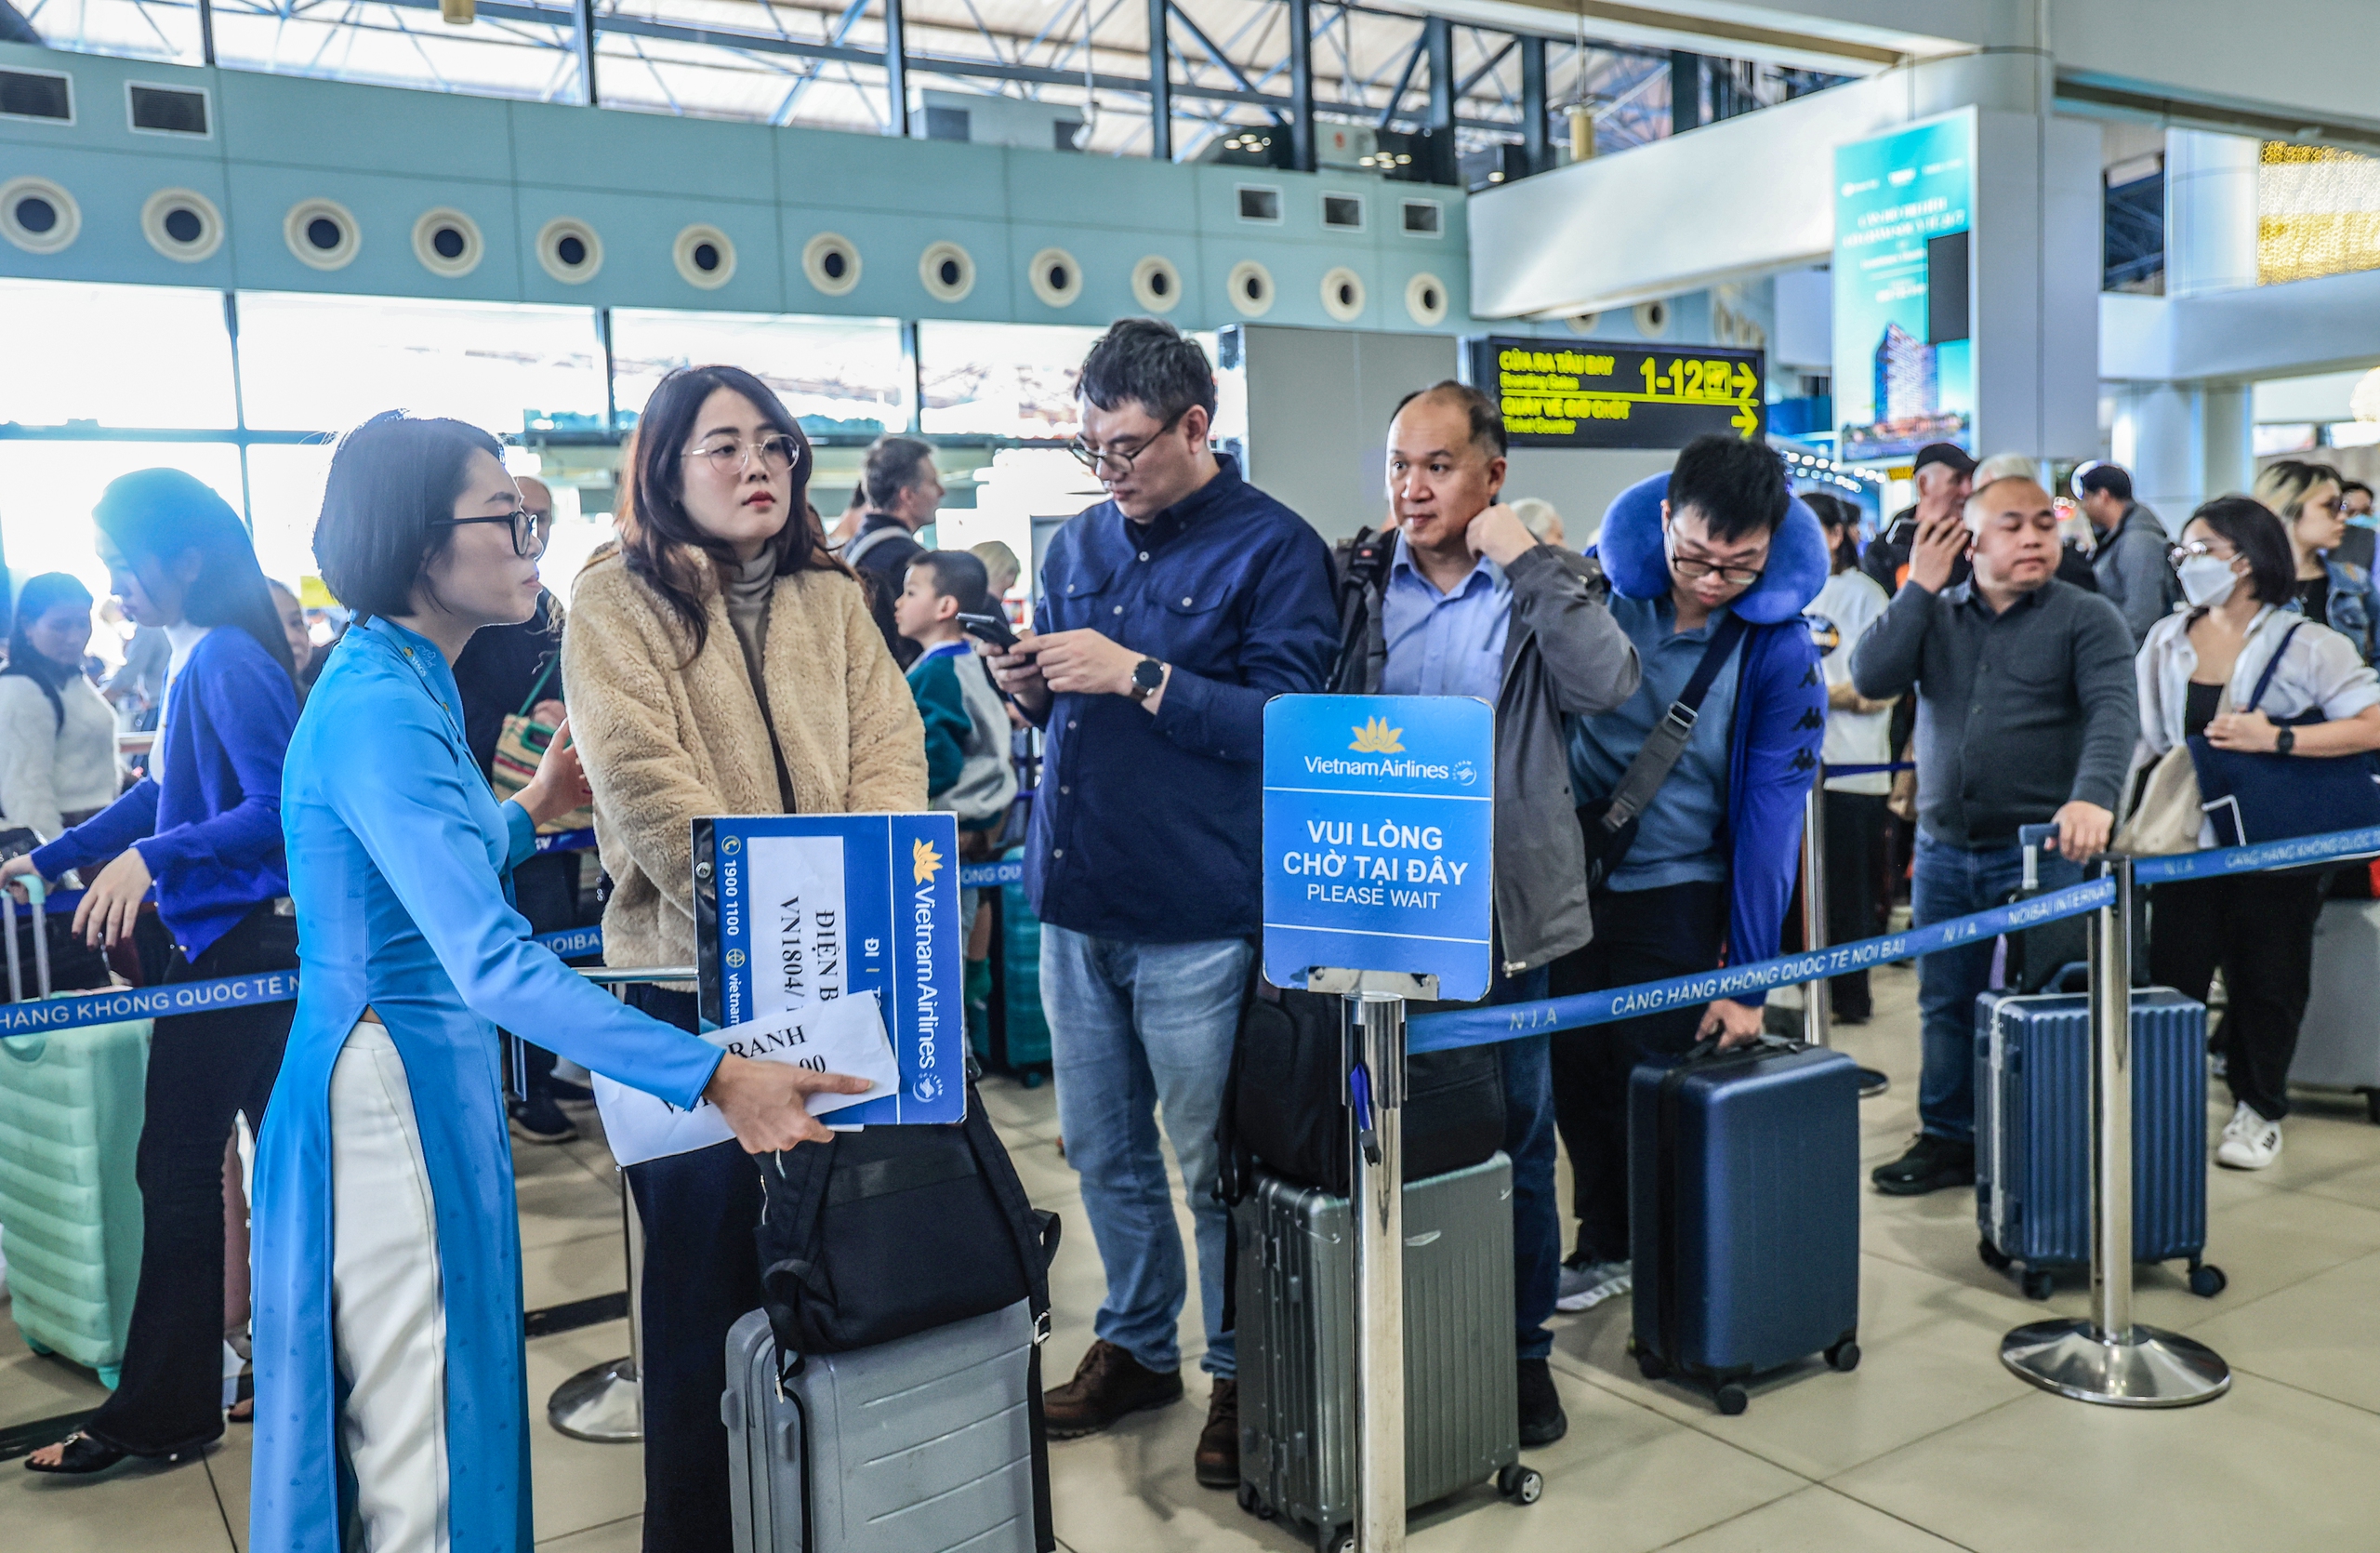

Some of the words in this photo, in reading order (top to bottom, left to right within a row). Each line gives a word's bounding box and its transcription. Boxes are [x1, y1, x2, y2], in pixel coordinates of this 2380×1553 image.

[1640, 357, 1704, 399] 1-12
[1306, 819, 1353, 845] VUI
[1362, 818, 1443, 851] LÒNG
[724, 859, 738, 897] 1900
[1283, 848, 1346, 877] CHỜ
[1354, 856, 1398, 885] TẠI
[1406, 855, 1468, 885] ĐÂY
[1307, 884, 1383, 906] PLEASE
[1391, 889, 1441, 909] WAIT
[726, 900, 740, 936] 1100
[780, 896, 805, 998] VN1804/
[812, 909, 840, 977] ĐIỆN
[864, 937, 880, 957] ĐI
